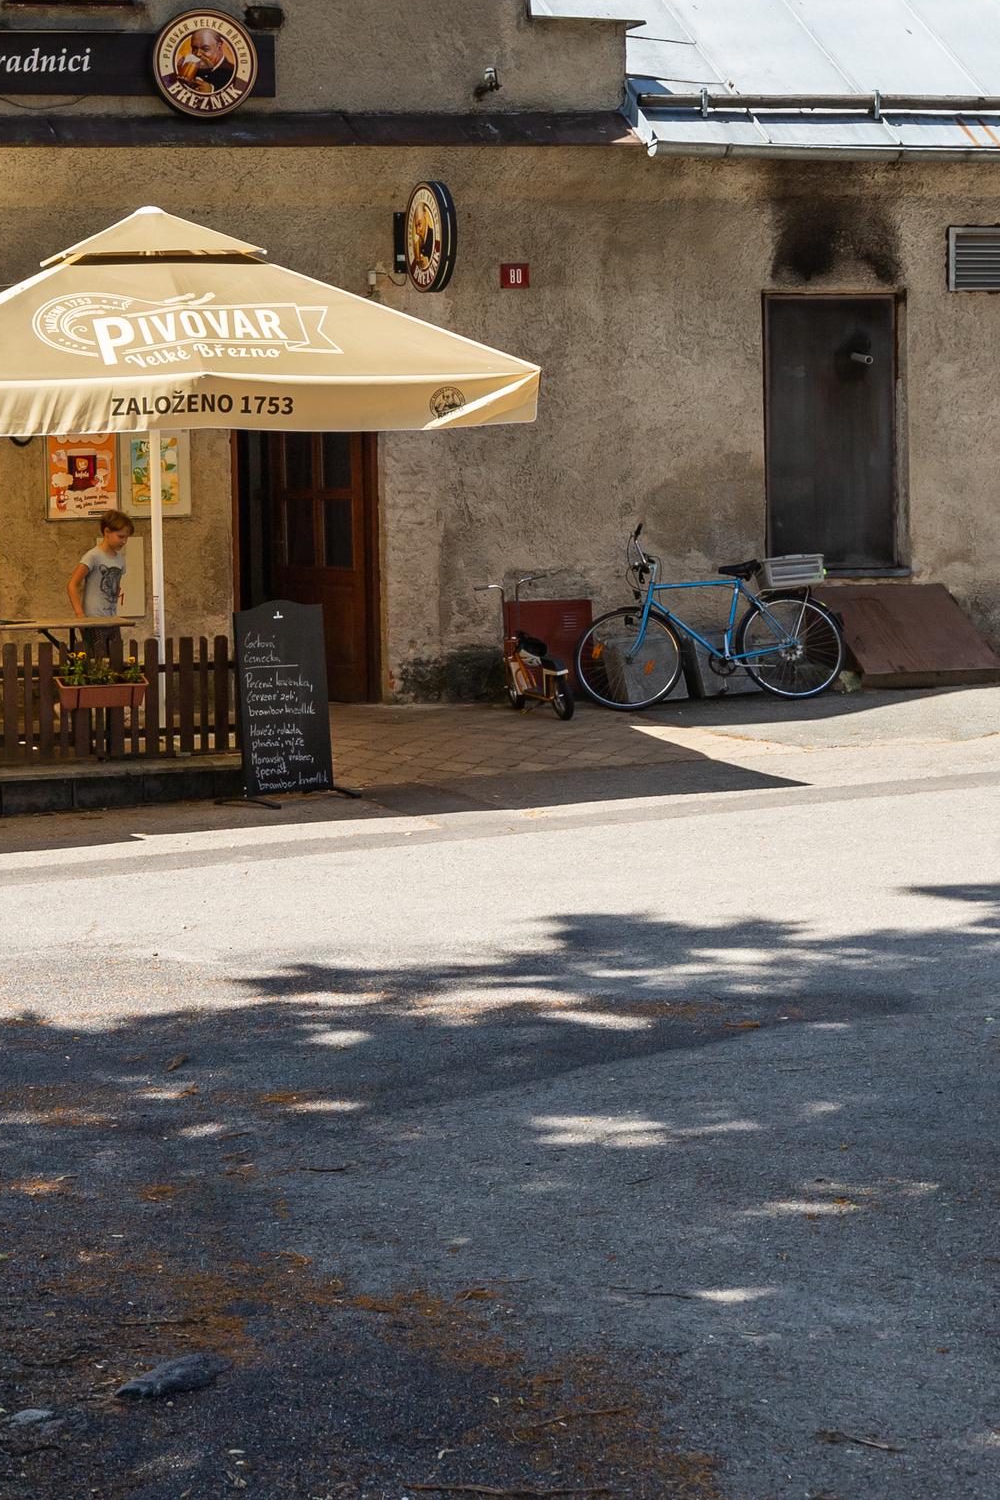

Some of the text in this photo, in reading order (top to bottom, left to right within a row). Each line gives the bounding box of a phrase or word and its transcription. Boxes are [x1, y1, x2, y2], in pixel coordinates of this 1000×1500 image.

[163, 24, 190, 59] PIVOVAR
[193, 18, 223, 30] VELKÉ
[64, 297, 92, 308] 1753
[92, 308, 289, 366] PIVOVAR
[124, 342, 281, 368] Velké Březno
[112, 390, 294, 416] ZALOŽENO 1753
